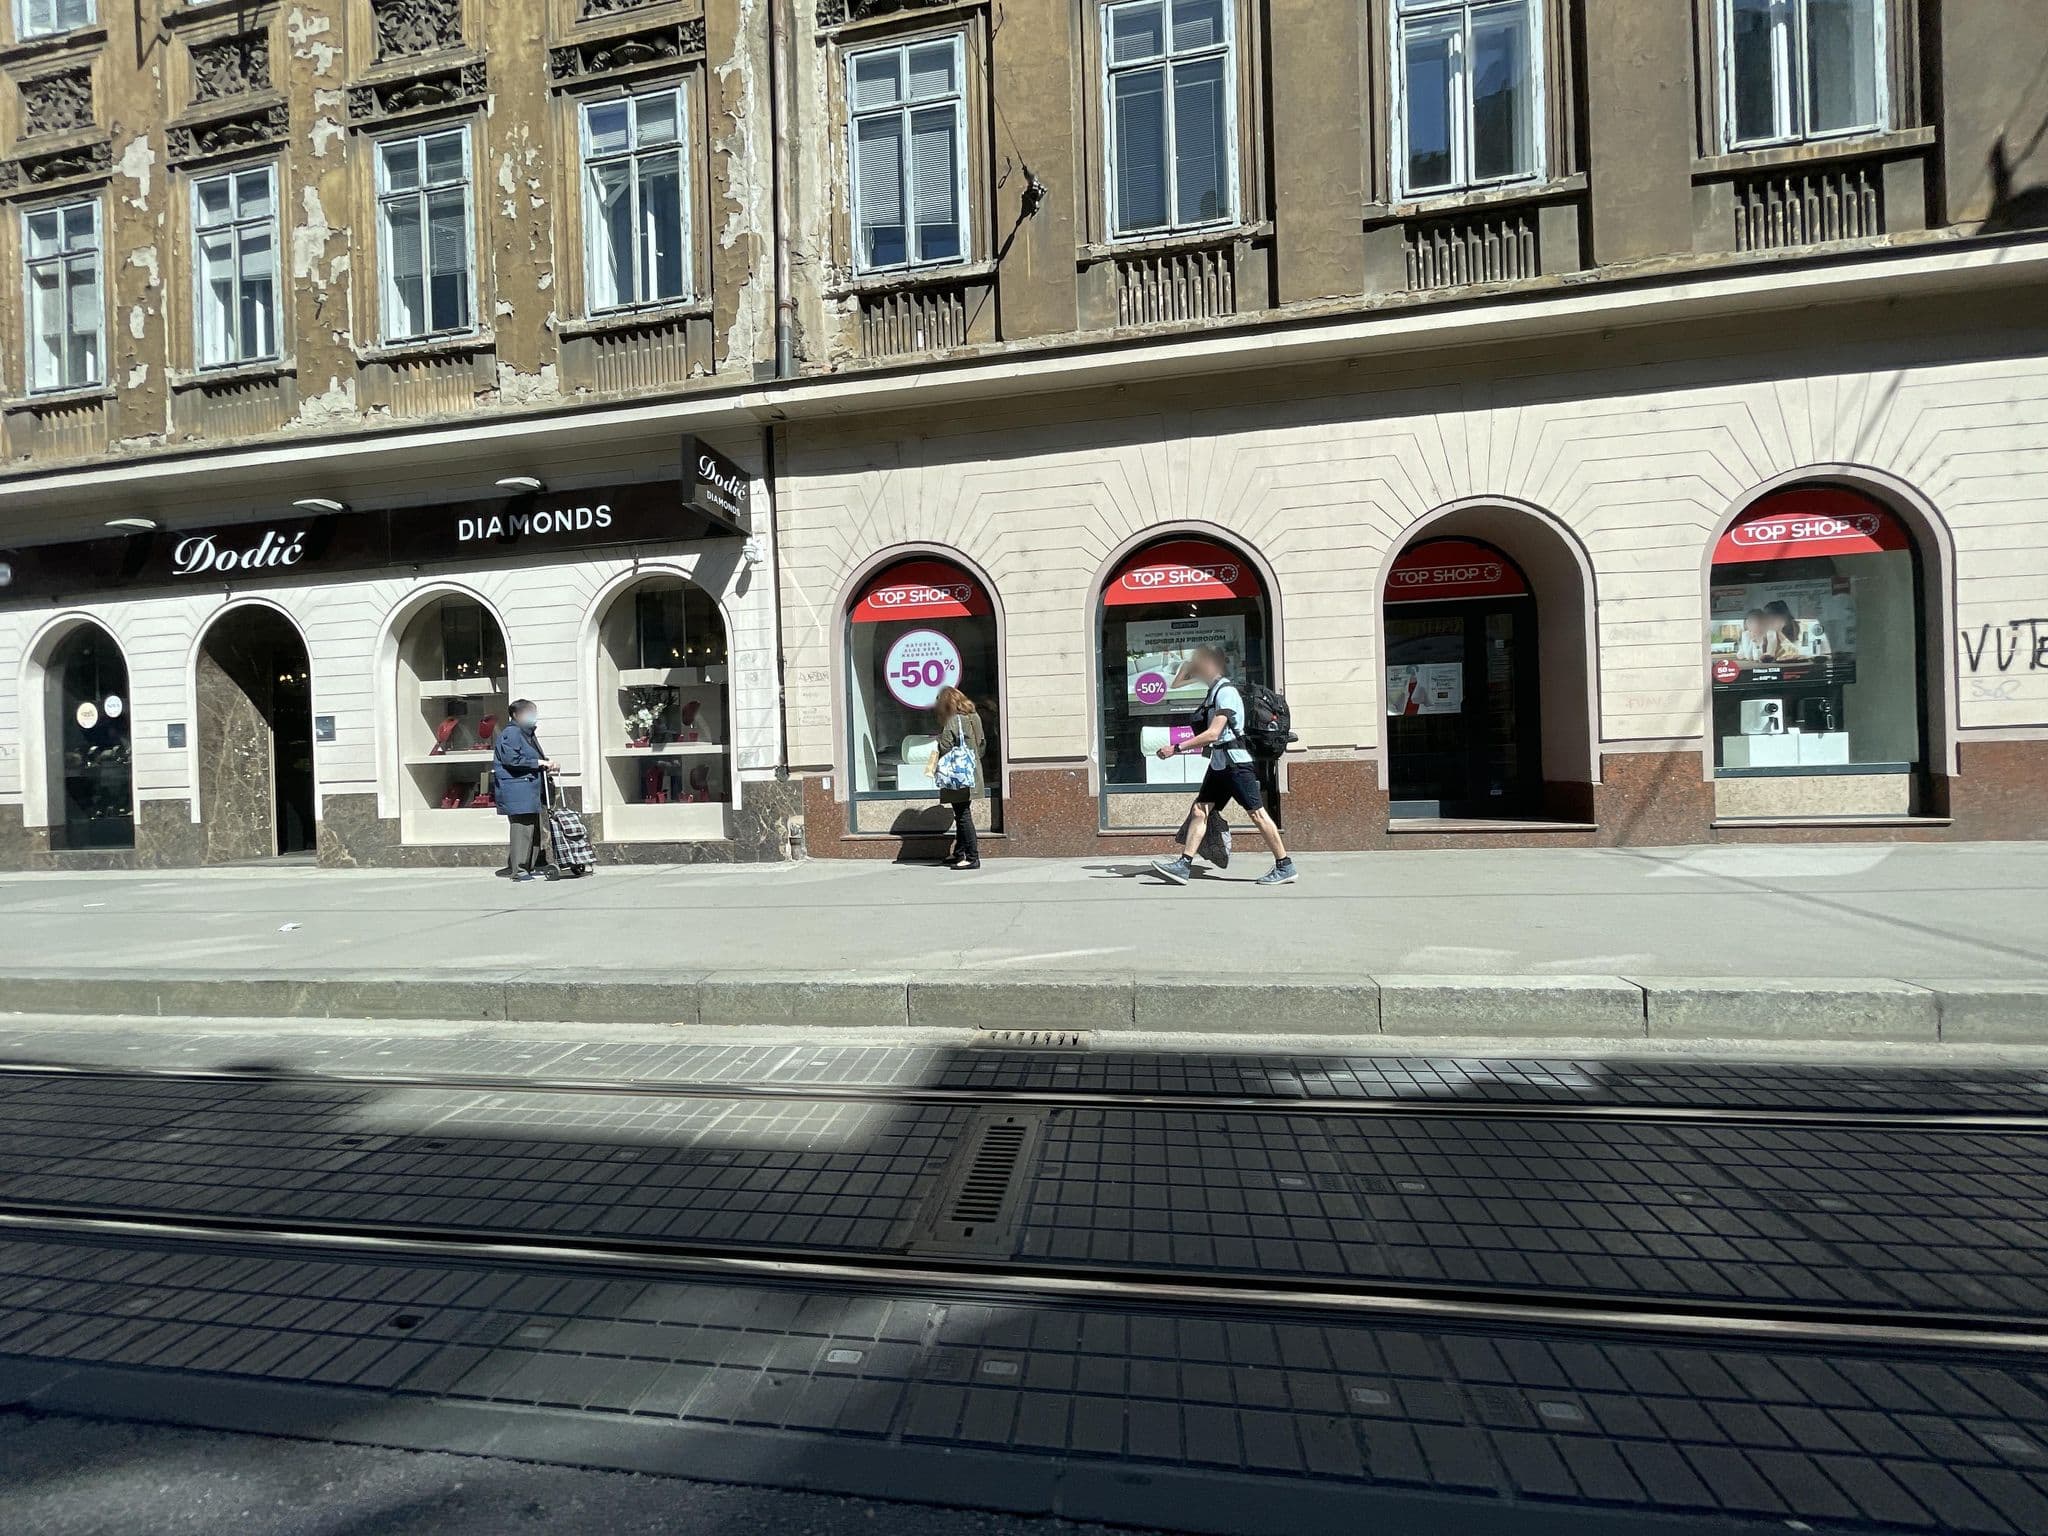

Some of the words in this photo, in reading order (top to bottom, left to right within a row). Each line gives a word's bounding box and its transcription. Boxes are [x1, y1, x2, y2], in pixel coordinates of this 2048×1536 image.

[698, 455, 747, 501] Dodić
[706, 489, 741, 517] DIAMONDS
[457, 504, 613, 542] DIAMONDS
[1743, 525, 1787, 541] TOP
[1791, 519, 1850, 539] SHOP
[172, 530, 307, 576] Dodić
[1132, 571, 1166, 586] TOP
[1168, 568, 1216, 584] SHOP
[1396, 570, 1430, 584] TOP
[1433, 567, 1480, 582] SHOP
[876, 590, 907, 605] TOP
[909, 587, 951, 603] SHOP
[890, 659, 955, 688] -50%
[1136, 682, 1165, 694] -50%
